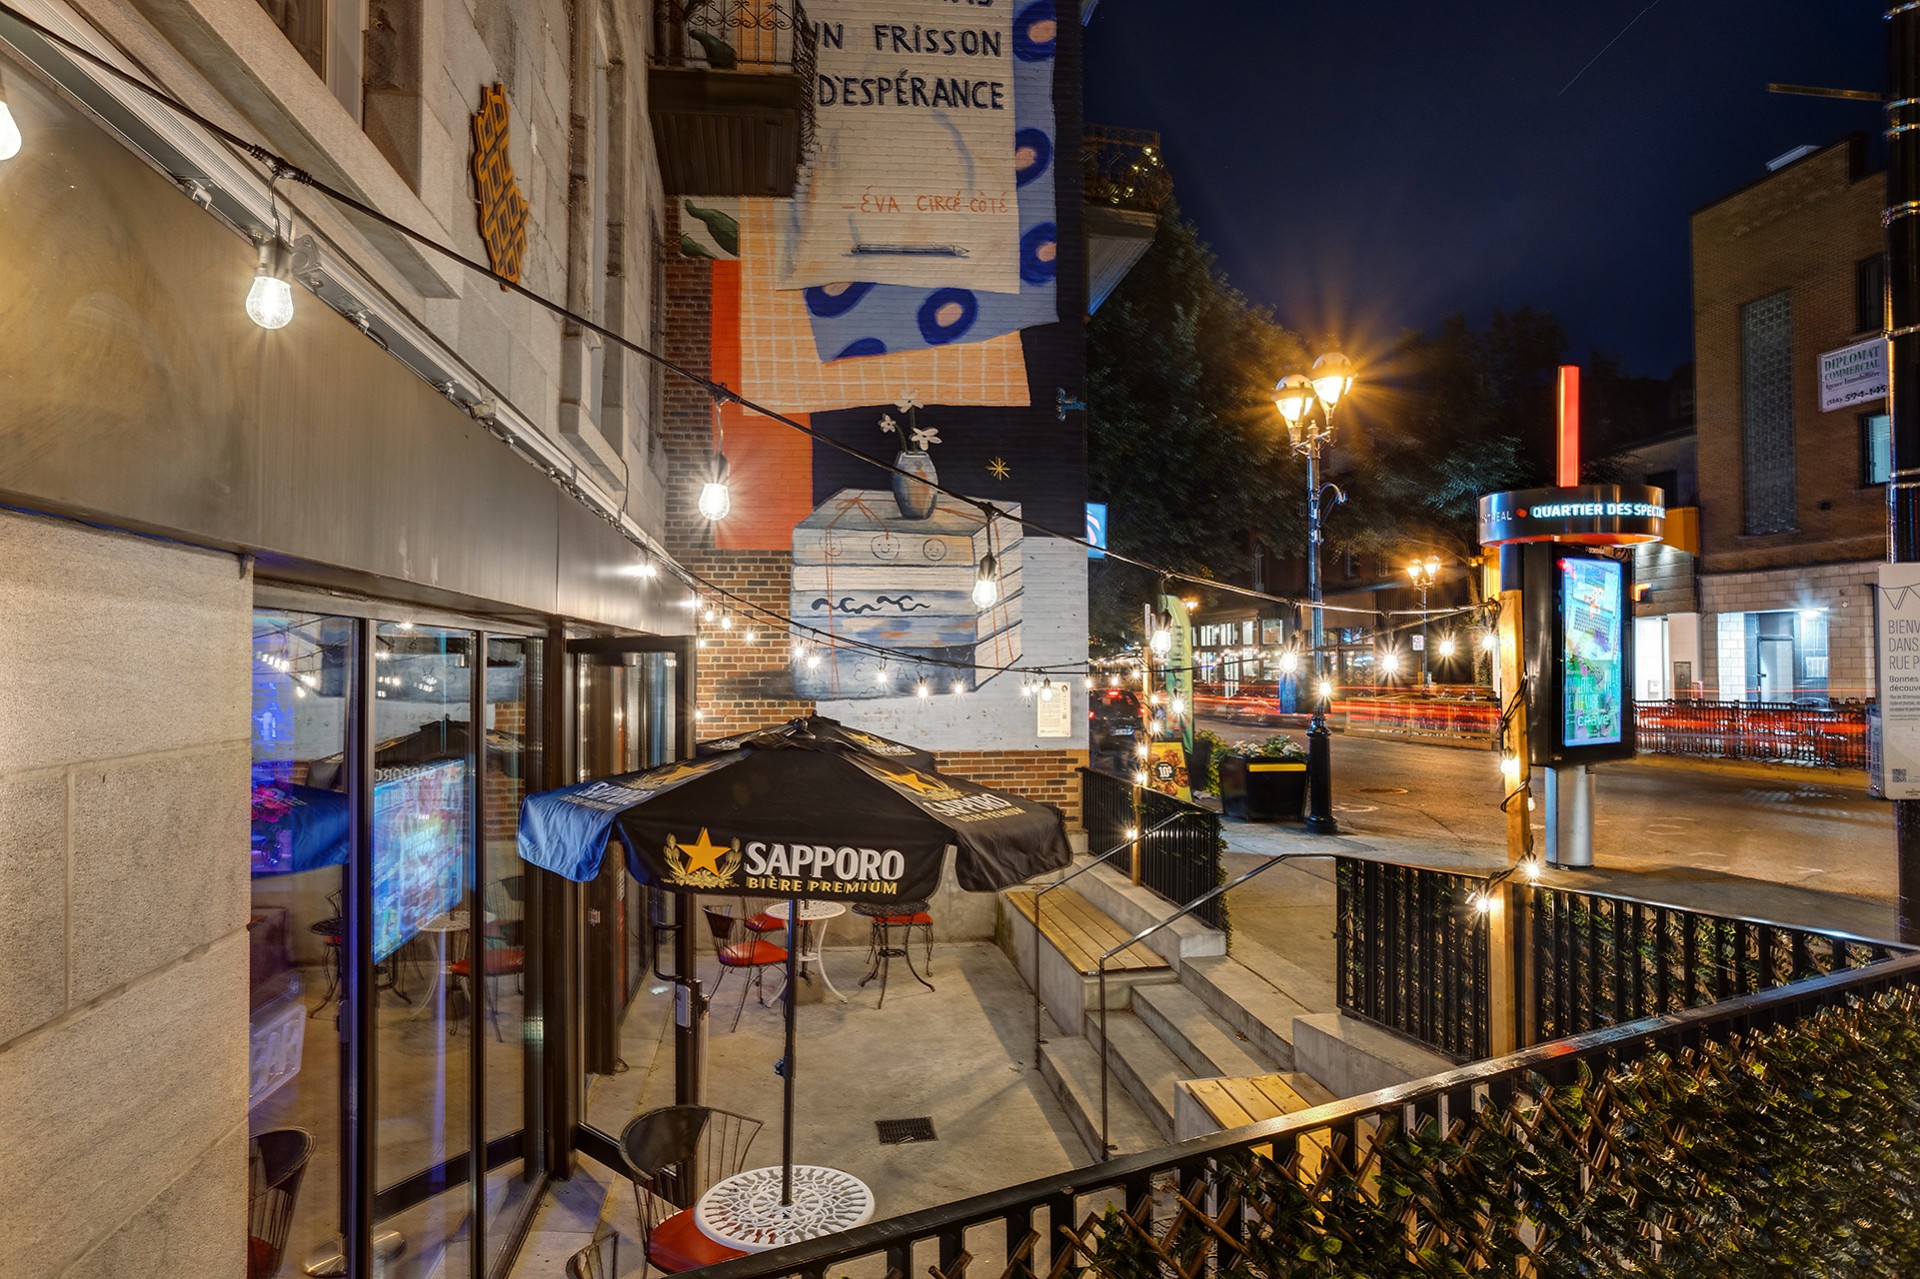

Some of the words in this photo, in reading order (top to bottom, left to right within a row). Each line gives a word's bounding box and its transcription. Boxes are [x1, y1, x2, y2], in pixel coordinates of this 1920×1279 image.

[818, 69, 1004, 109] D'ESPÉRANCE
[1824, 346, 1880, 371] DIPLOMAT
[1825, 360, 1881, 381] COMMERCIAL
[1845, 384, 1888, 402] 594-149
[1530, 502, 1603, 518] QUARTIER
[1606, 502, 1632, 516] DES
[1889, 637, 1919, 652] DANS
[1889, 656, 1910, 670] RUE
[1889, 675, 1919, 683] Bonnes
[744, 841, 905, 881] SAPPORO
[746, 875, 803, 892] BIÈRE
[807, 880, 898, 895] PREMIUM
